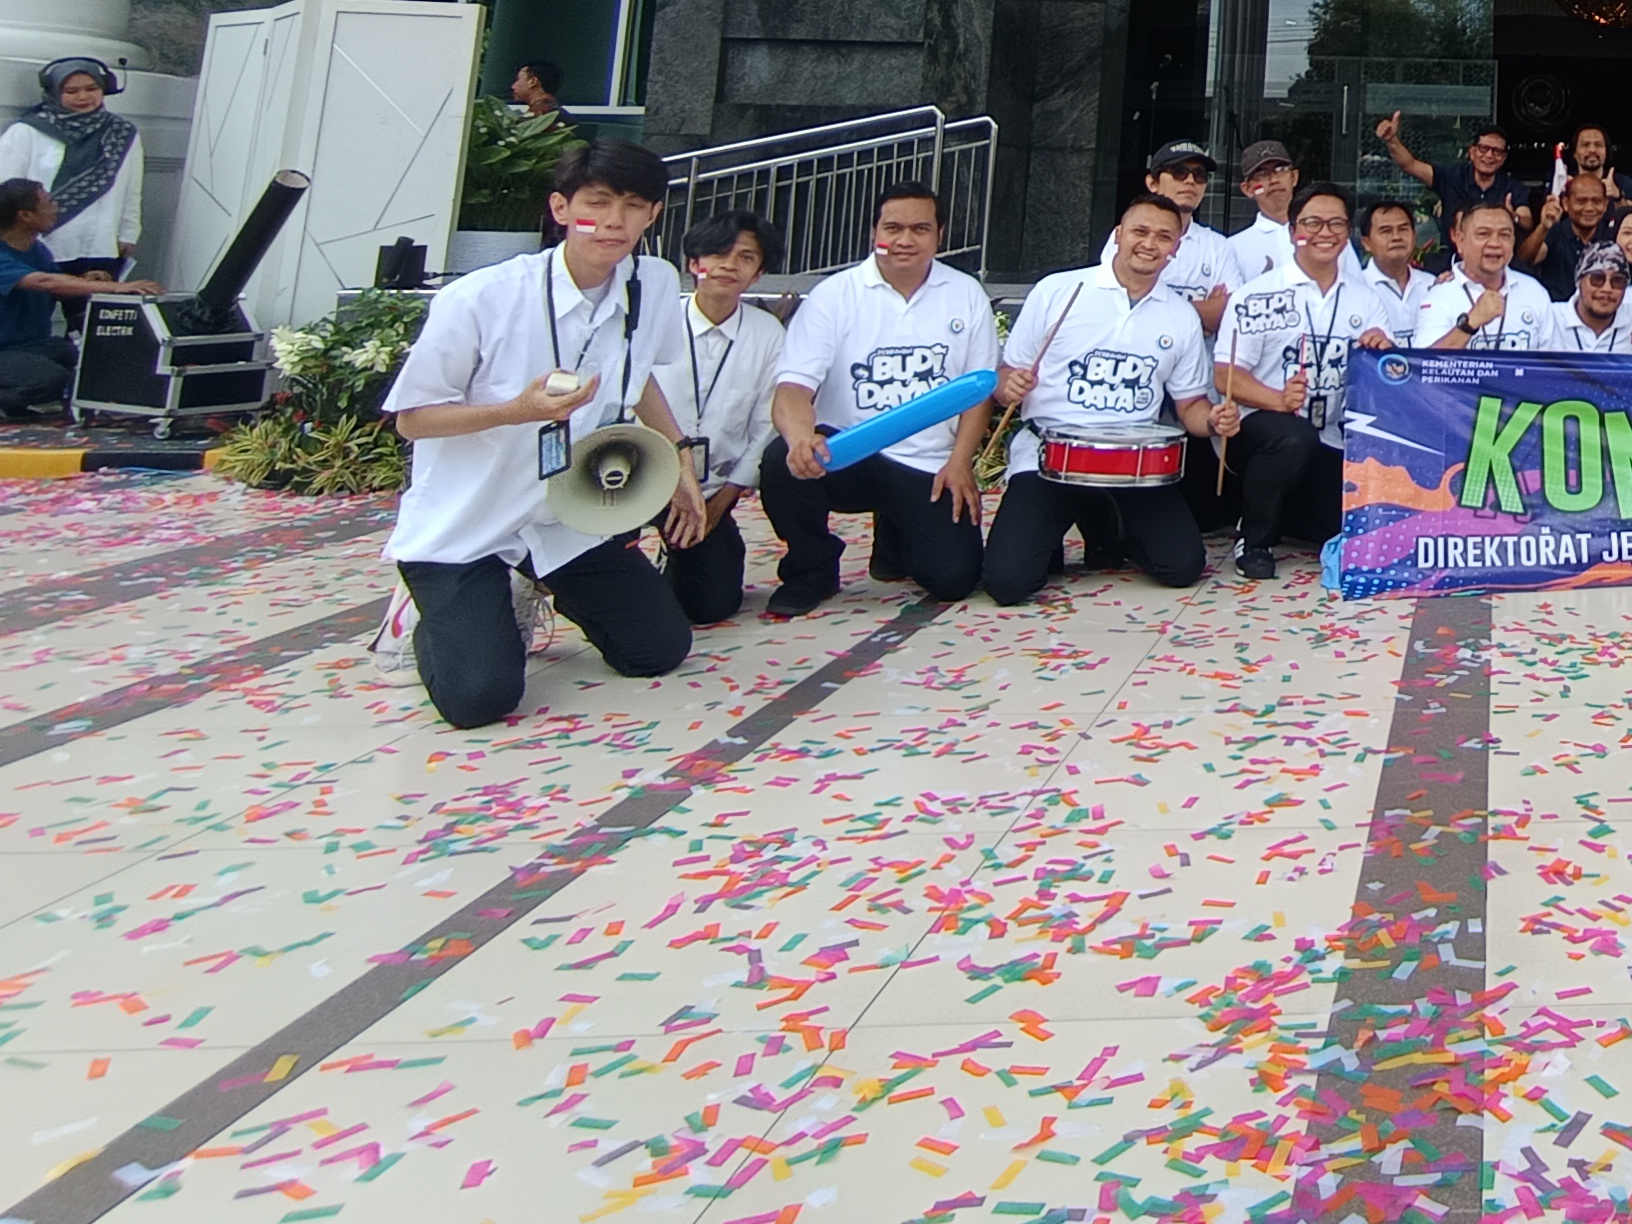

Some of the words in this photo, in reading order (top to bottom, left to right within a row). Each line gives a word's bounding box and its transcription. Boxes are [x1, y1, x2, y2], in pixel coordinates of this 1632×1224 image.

[1240, 311, 1288, 334] DAYA
[1421, 360, 1494, 369] KEMENTERIAN
[1421, 368, 1475, 377] KELAUTAN
[1476, 369, 1499, 377] DAN
[1421, 376, 1480, 385] PERIKANAN
[1069, 378, 1135, 412] DAYA
[1417, 532, 1593, 569] DIREKTORAT
